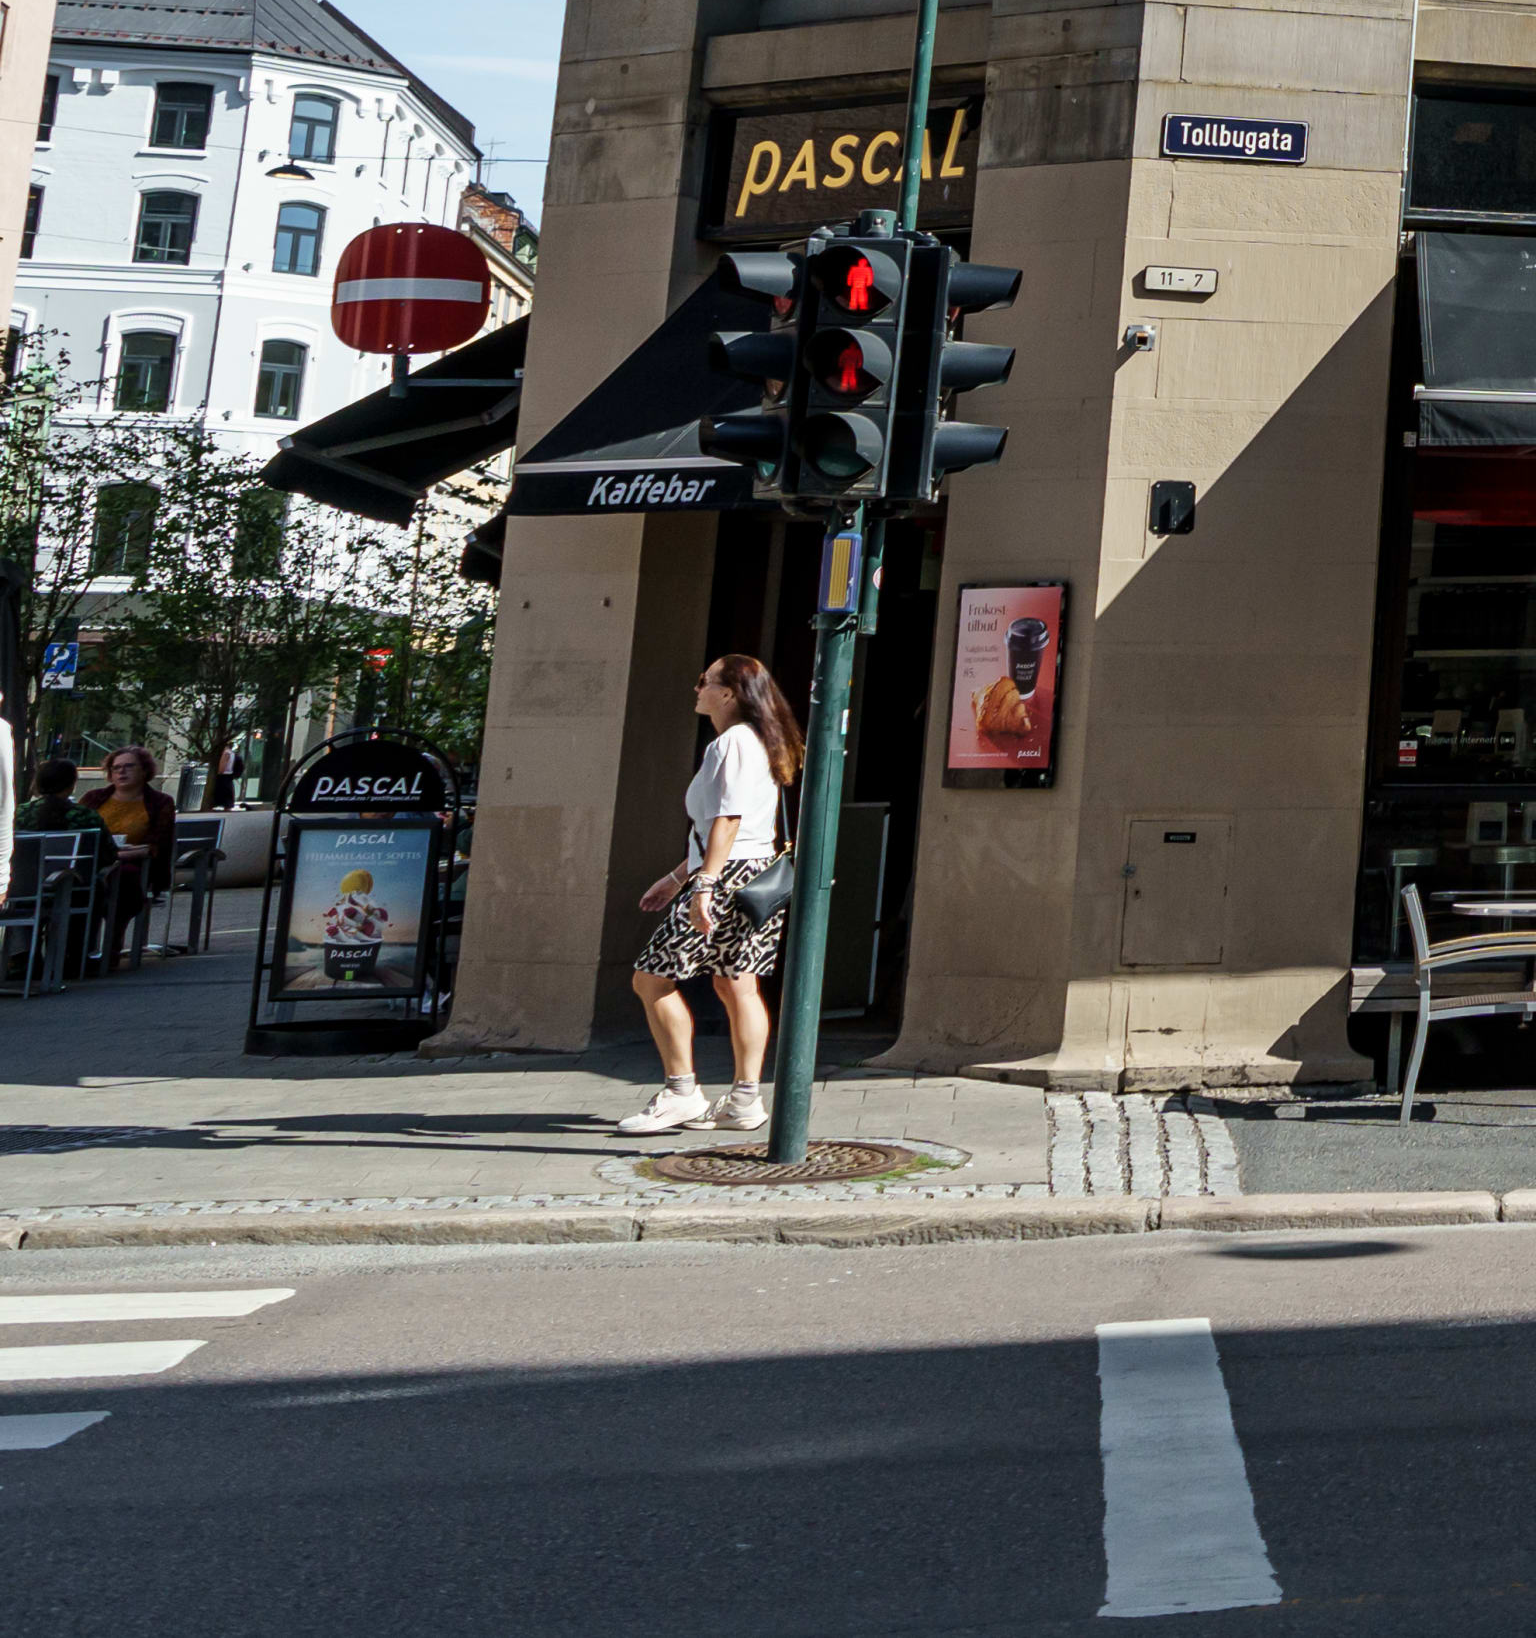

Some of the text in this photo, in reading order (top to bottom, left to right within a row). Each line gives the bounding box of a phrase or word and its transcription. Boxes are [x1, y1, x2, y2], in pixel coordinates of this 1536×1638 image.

[1180, 121, 1293, 155] Tollbugata
[1160, 271, 1173, 286] 11
[1194, 273, 1204, 288] 7
[586, 473, 717, 506] Kaffebar
[967, 619, 998, 632] tilbud
[311, 771, 424, 803] PASCAL
[335, 831, 396, 849] PASCAL
[330, 946, 374, 959] PASCAL
